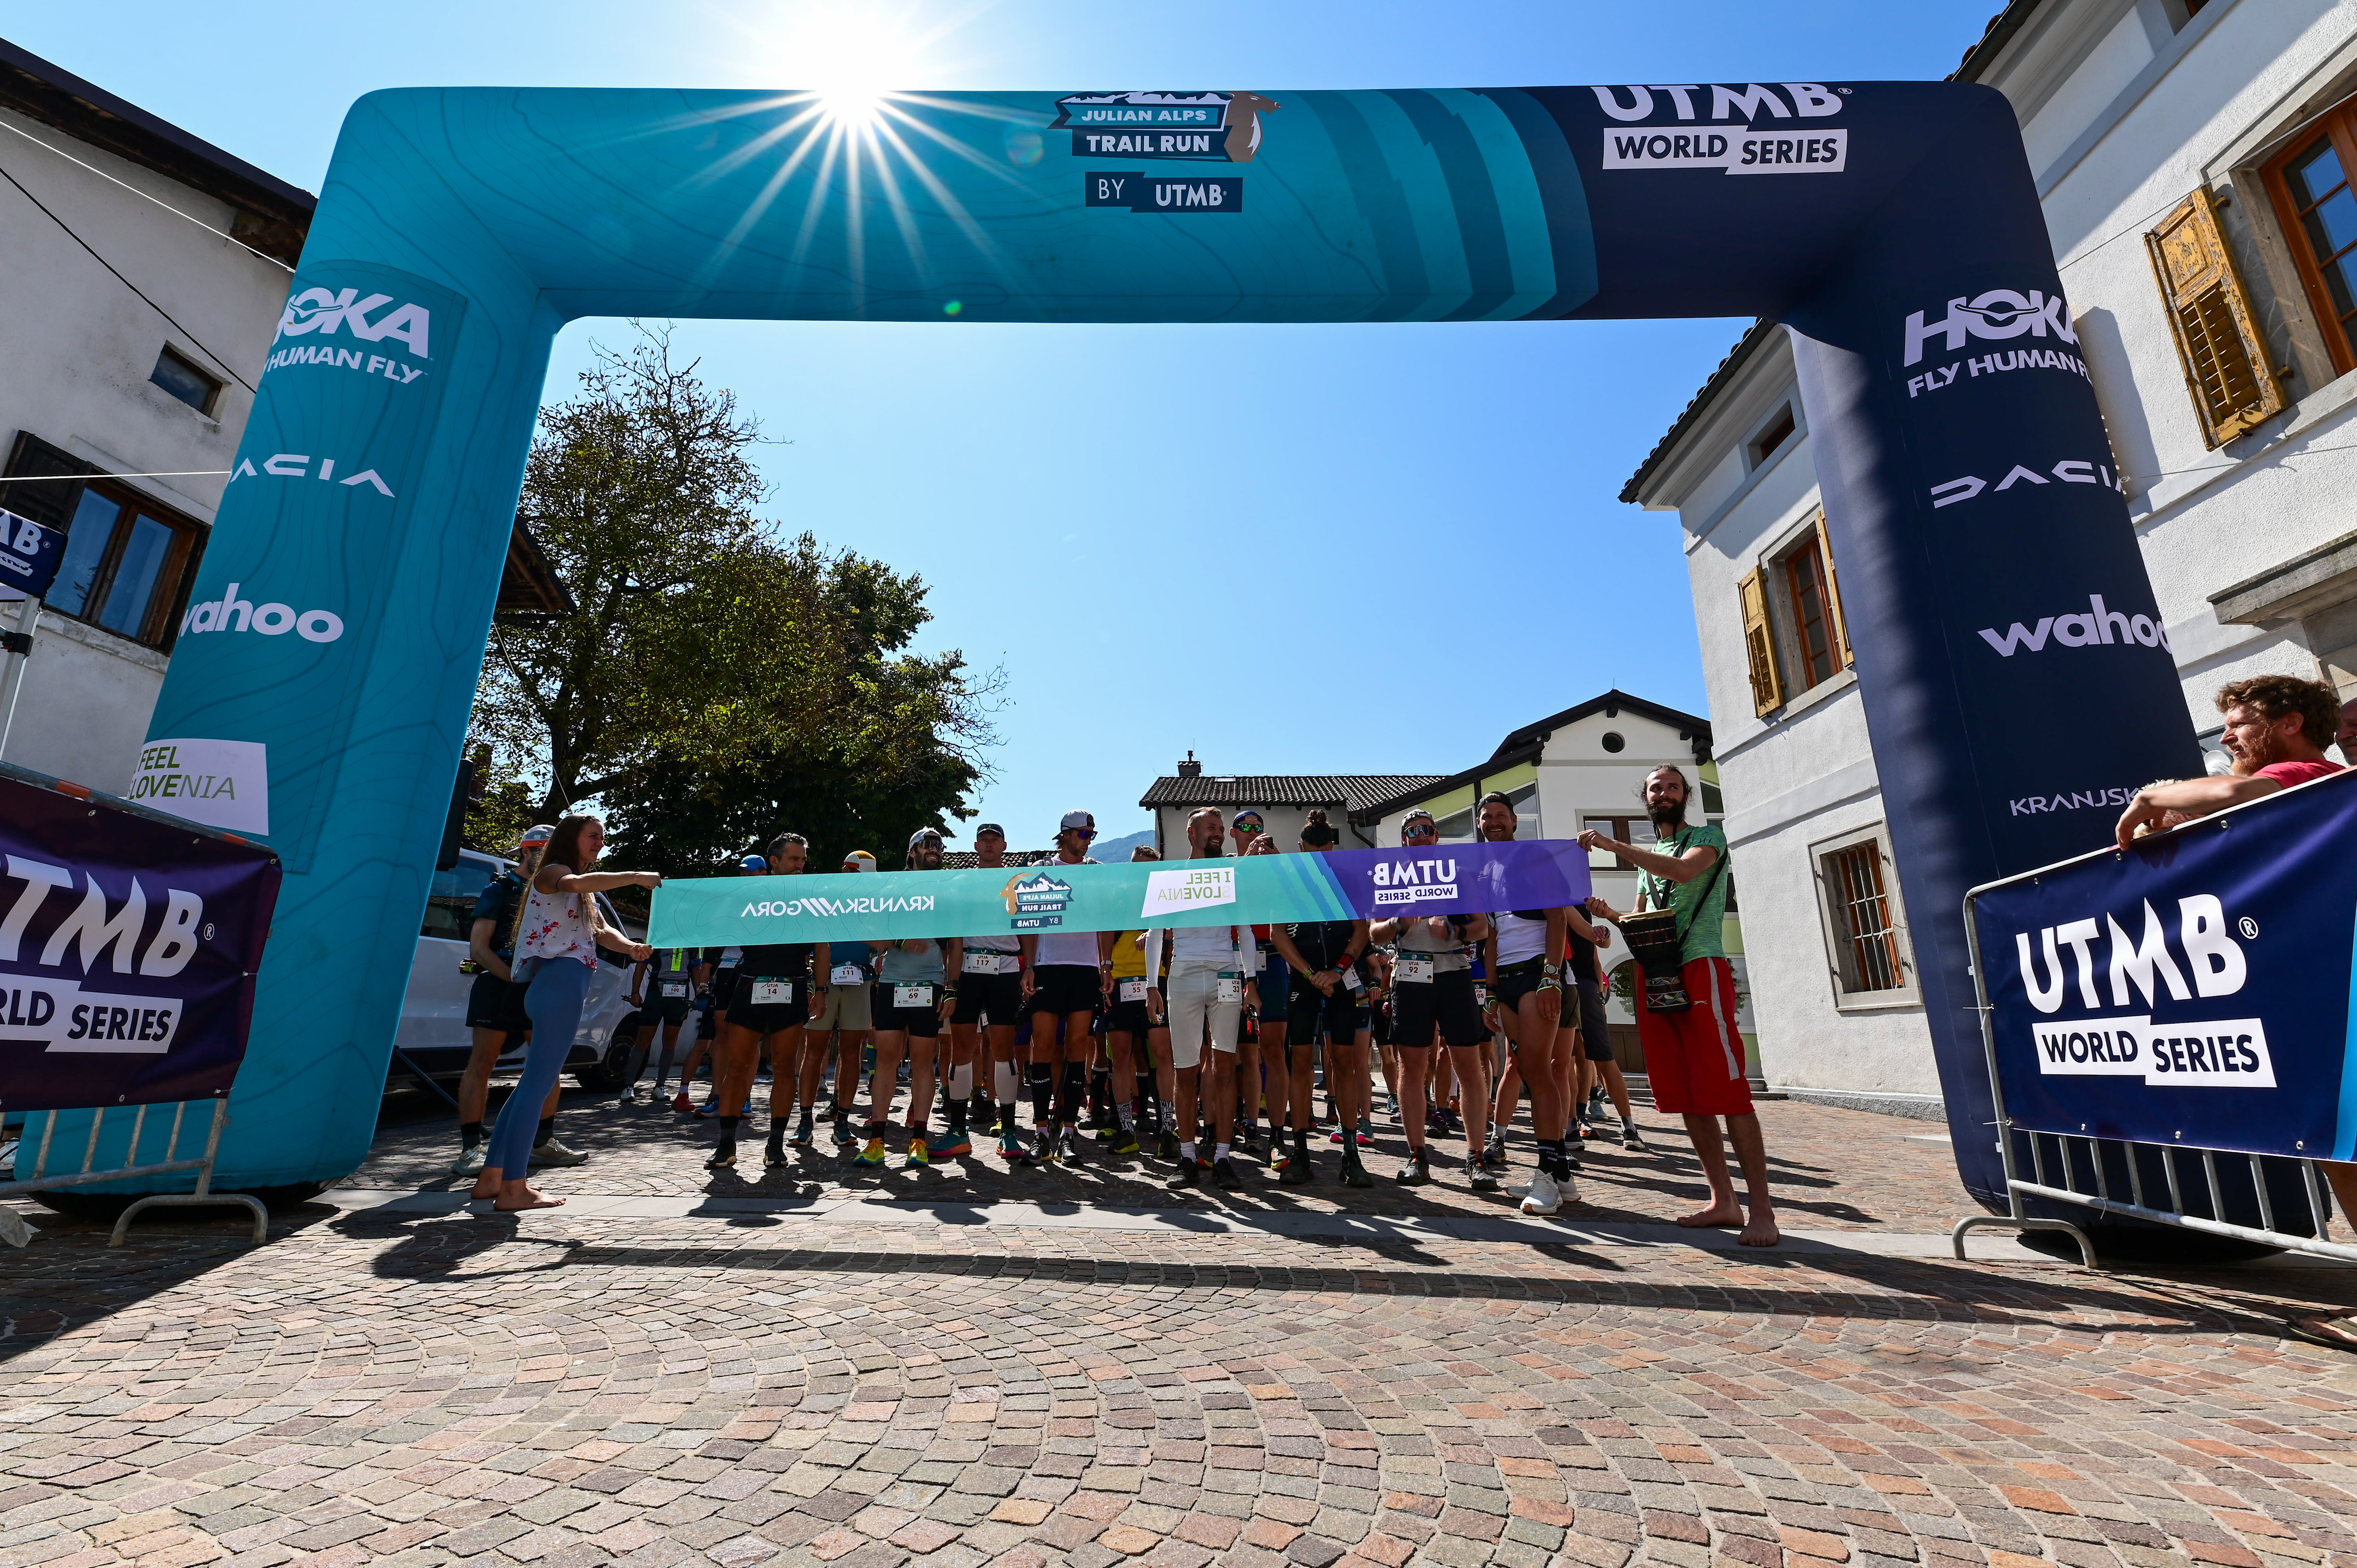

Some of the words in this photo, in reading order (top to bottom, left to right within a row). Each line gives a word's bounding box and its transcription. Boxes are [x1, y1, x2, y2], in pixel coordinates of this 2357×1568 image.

[1081, 110, 1153, 121] JULIAN
[1158, 110, 1207, 121] ALPS
[1086, 135, 1154, 152] TRAIL
[1160, 135, 1209, 152] RUN
[1614, 134, 1728, 160] WORLD
[1740, 138, 1838, 165] SERIES
[1098, 179, 1125, 199] BY
[267, 346, 363, 372] HUMAN
[366, 354, 424, 384] FLY
[1907, 361, 1960, 398] FLY
[1968, 349, 2077, 378] HUMAN
[228, 454, 395, 498] ACIA
[138, 746, 181, 772] FEEL
[128, 774, 235, 801] LOVENIA
[2009, 787, 2141, 816] KRANJSK
[67, 1004, 173, 1042] SERIES
[2041, 1030, 2139, 1064] WORLD
[2152, 1034, 2259, 1073] SERIES
